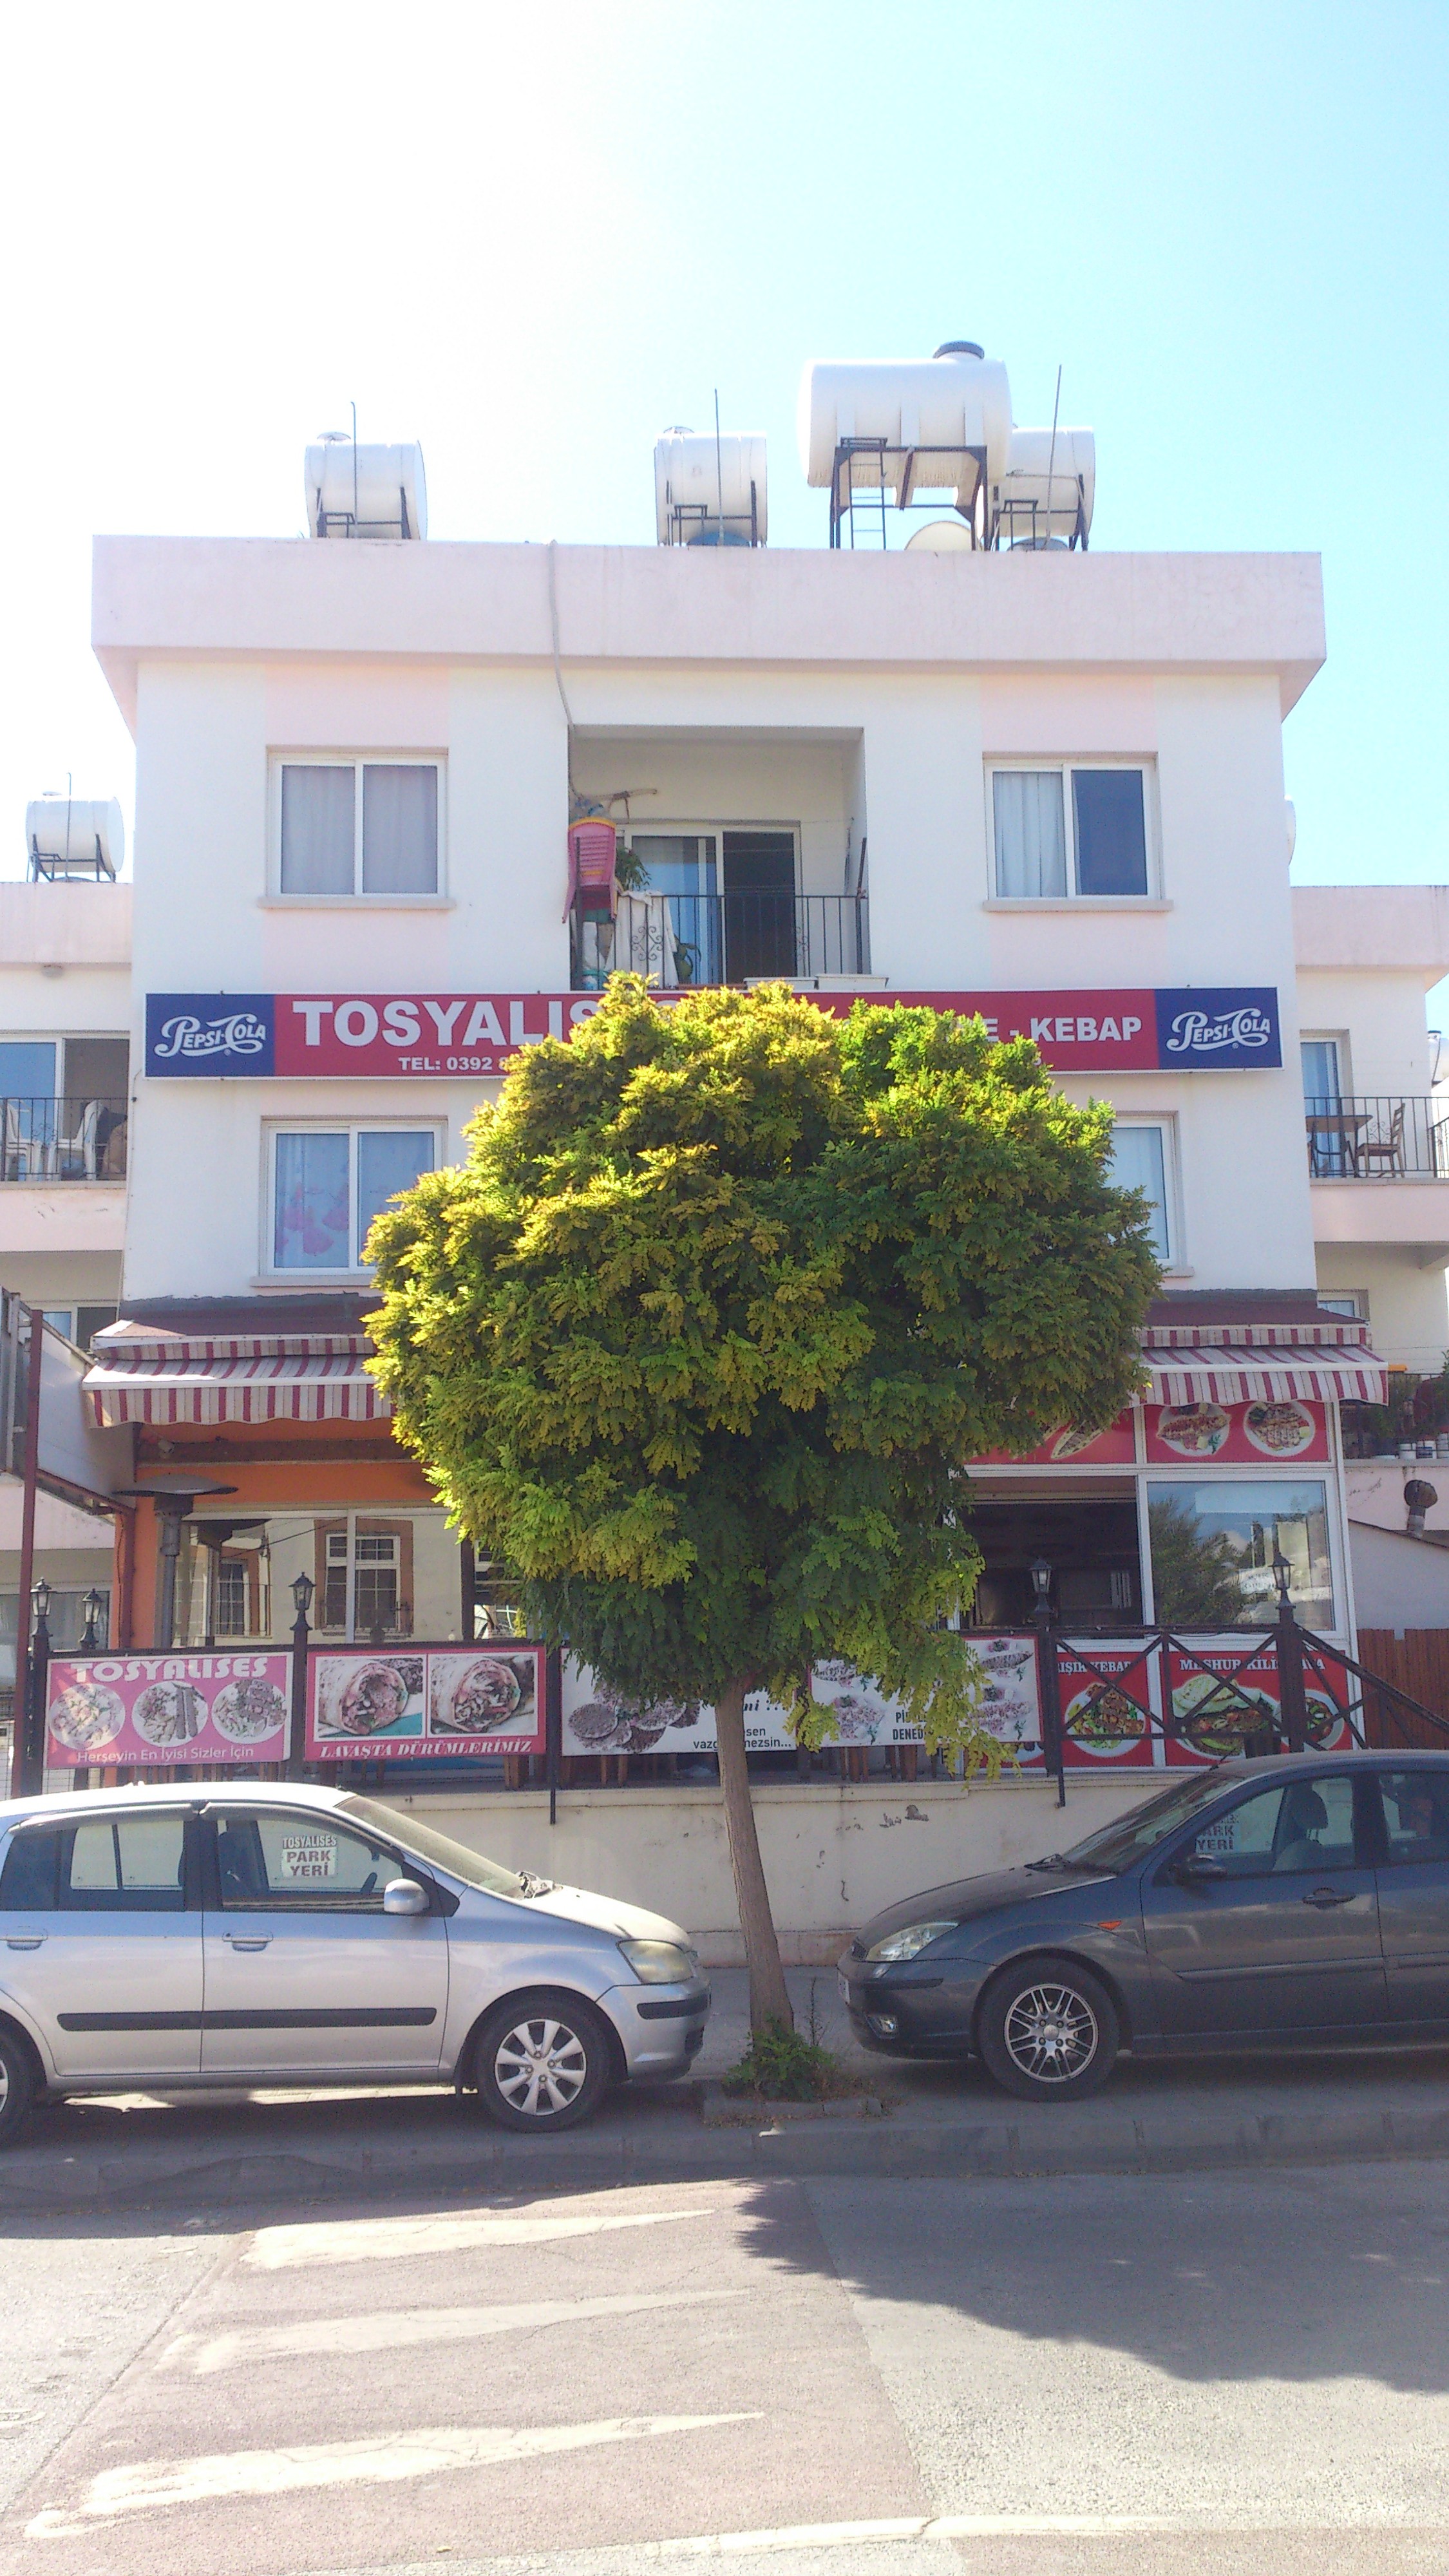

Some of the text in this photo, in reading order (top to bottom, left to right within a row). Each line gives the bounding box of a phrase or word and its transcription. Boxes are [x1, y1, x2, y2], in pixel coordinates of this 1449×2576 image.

[1030, 1016, 1142, 1043] KEBAP
[398, 1057, 440, 1070] TEL:
[446, 1057, 493, 1070] 0392
[71, 1657, 268, 1683] TOSYALISES
[1246, 1654, 1279, 1671] KİLİ
[77, 1749, 137, 1764] Herşeyin
[140, 1748, 157, 1761] En
[191, 1746, 226, 1759] Sizler
[230, 1745, 254, 1759] İçin
[319, 1739, 533, 1759] LAVAŞTA DÜRÜMLERİMİZ
[282, 1835, 337, 1850] TOSYALISES
[1197, 1837, 1233, 1850] YERİ
[287, 1850, 331, 1863] PARK
[290, 1862, 329, 1877] YERİ
